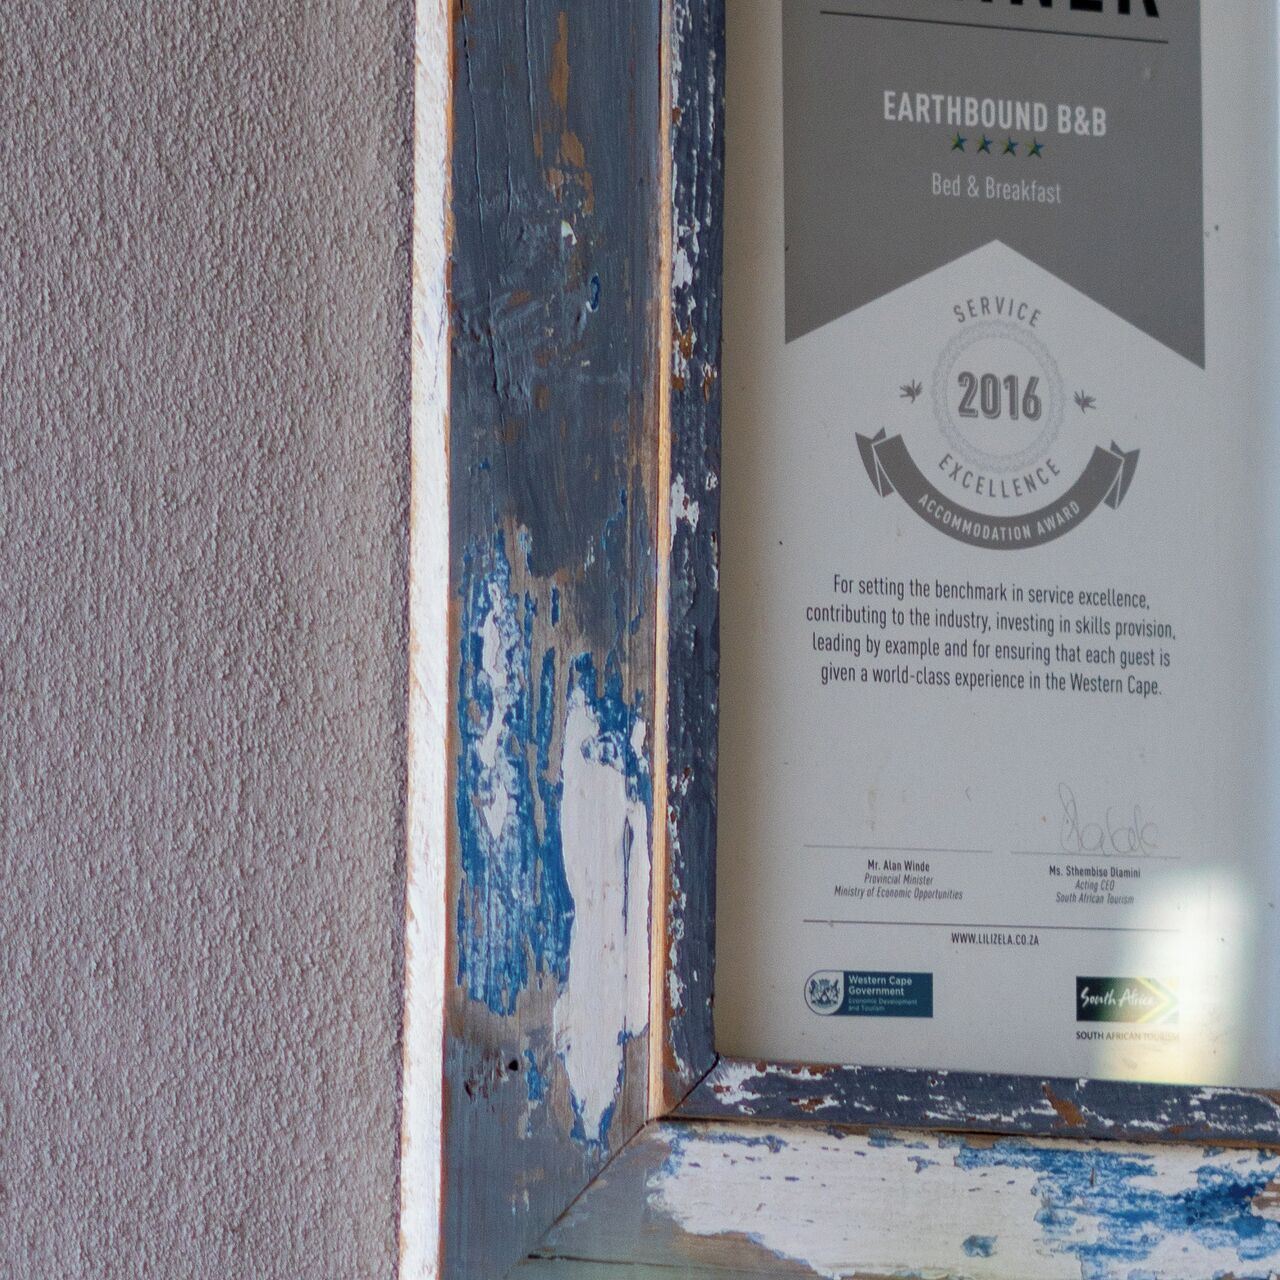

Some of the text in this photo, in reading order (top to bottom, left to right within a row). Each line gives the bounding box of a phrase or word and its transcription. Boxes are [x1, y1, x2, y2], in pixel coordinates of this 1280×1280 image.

[883, 90, 1107, 137] EARTHBOUND B&B
[932, 172, 1061, 204] Bed & Breakfast
[953, 296, 1041, 327] SERVICE
[957, 371, 1042, 421] 2016
[938, 453, 1060, 498] EXCELLENCE
[918, 494, 1080, 541] ACCOMMODATION AWARD
[834, 574, 1150, 609] For setting the benchmark in service excellence,
[806, 604, 1176, 640] contributing to the industry, investing in skills provision,
[812, 632, 1171, 669] leading by example and for ensuring that each guest is
[821, 662, 1162, 699] given a world-class experience in the Western Cape.
[868, 859, 930, 872] Mr. Alan Winde
[1049, 865, 1141, 879] Ms. Sthembiso Dlamini
[864, 872, 933, 886] Provincial Minister
[1075, 879, 1115, 892] Acting CEO
[834, 885, 963, 901] Ministry of Economic Opportunities
[1056, 892, 1134, 905] South African Tourism
[951, 932, 1039, 946] WWW.LILIZELA.CO.ZA
[848, 975, 912, 986] Western Cape
[848, 986, 904, 996] Government
[1081, 986, 1116, 1008] South
[1076, 1031, 1104, 1040] SOUTH
[1105, 1031, 1141, 1040] AFRICAN
